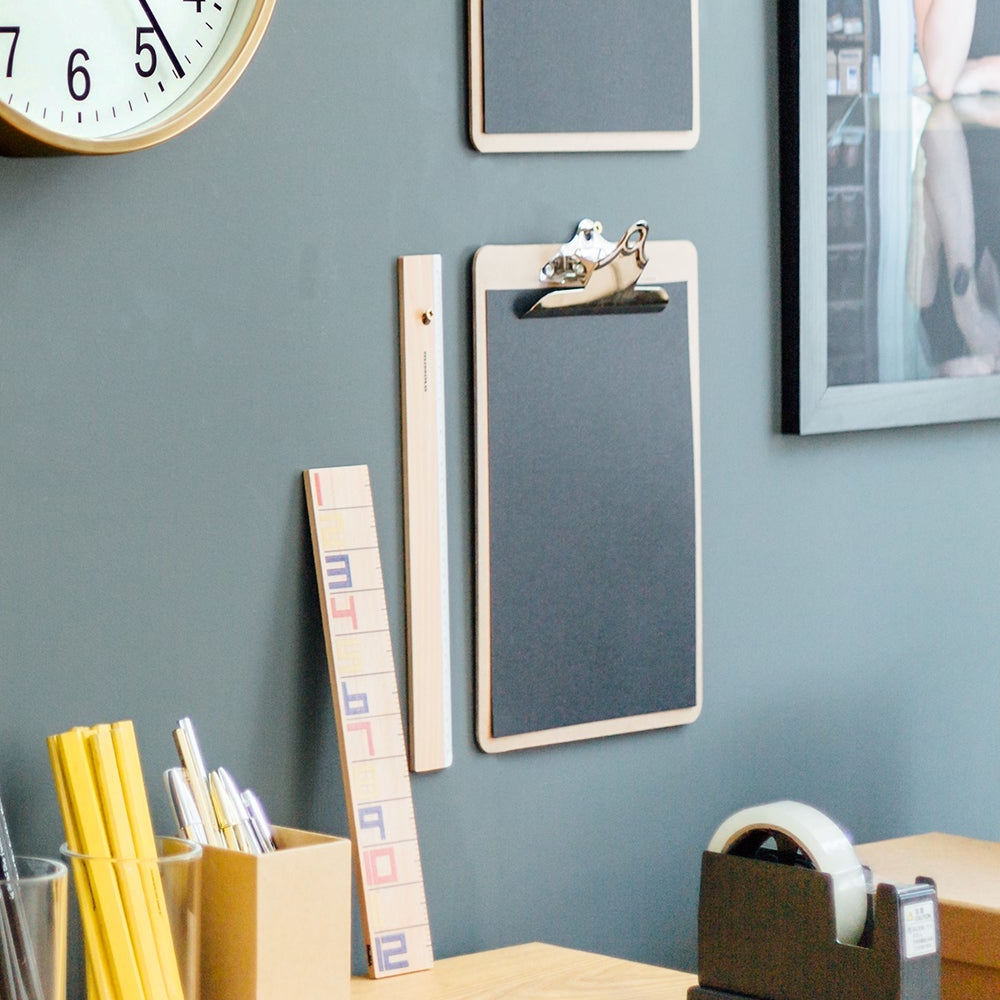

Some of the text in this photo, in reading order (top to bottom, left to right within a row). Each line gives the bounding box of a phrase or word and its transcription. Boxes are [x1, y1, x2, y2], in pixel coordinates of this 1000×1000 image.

[134, 26, 157, 78] 5
[67, 48, 91, 102] 6
[319, 511, 345, 548] 2
[330, 595, 358, 630] 4
[342, 682, 369, 716] 6
[346, 721, 375, 756] 7
[358, 806, 386, 840] 9
[363, 847, 398, 886] 10
[375, 933, 408, 971] 12
